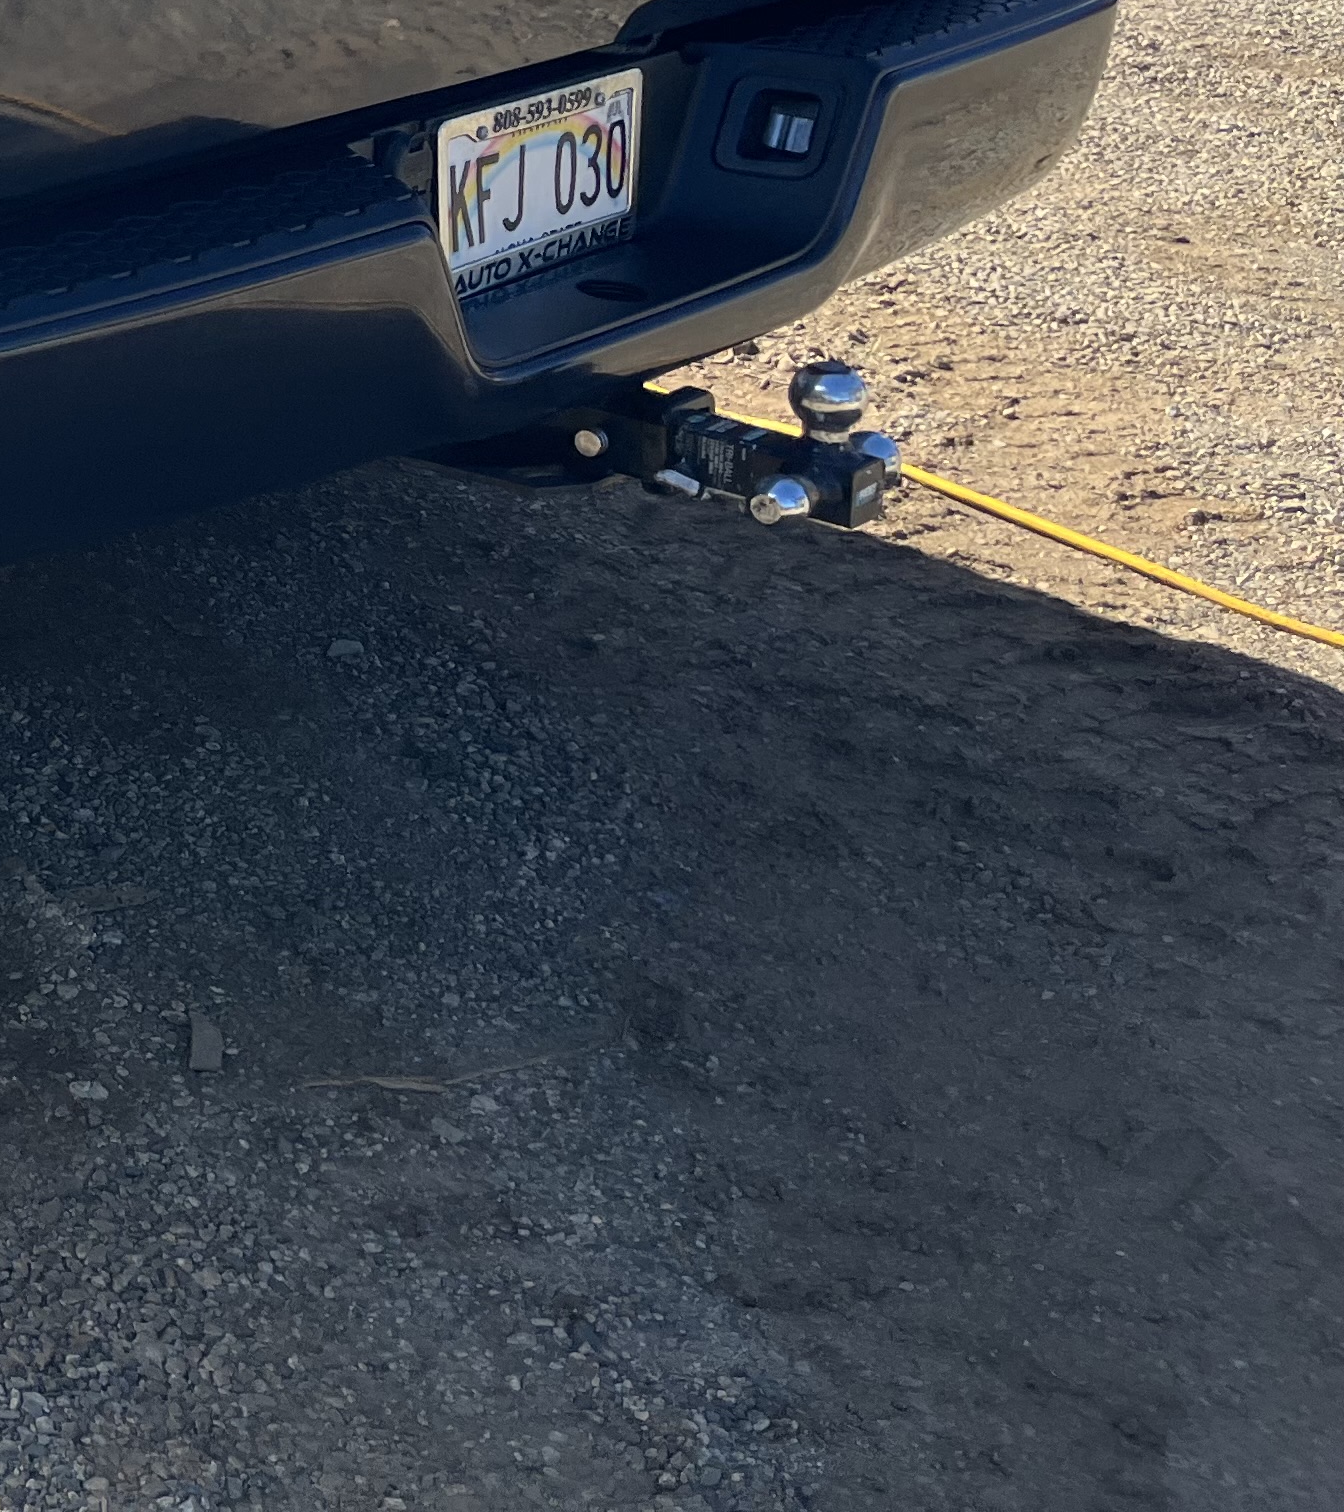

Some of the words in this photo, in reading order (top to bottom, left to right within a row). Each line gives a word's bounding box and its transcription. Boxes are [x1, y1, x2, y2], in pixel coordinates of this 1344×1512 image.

[492, 87, 593, 133] 808-593-0599
[450, 144, 527, 253] KFJ
[554, 119, 627, 215] 030
[454, 256, 512, 295] AUTO
[517, 215, 633, 273] X-CHANGE
